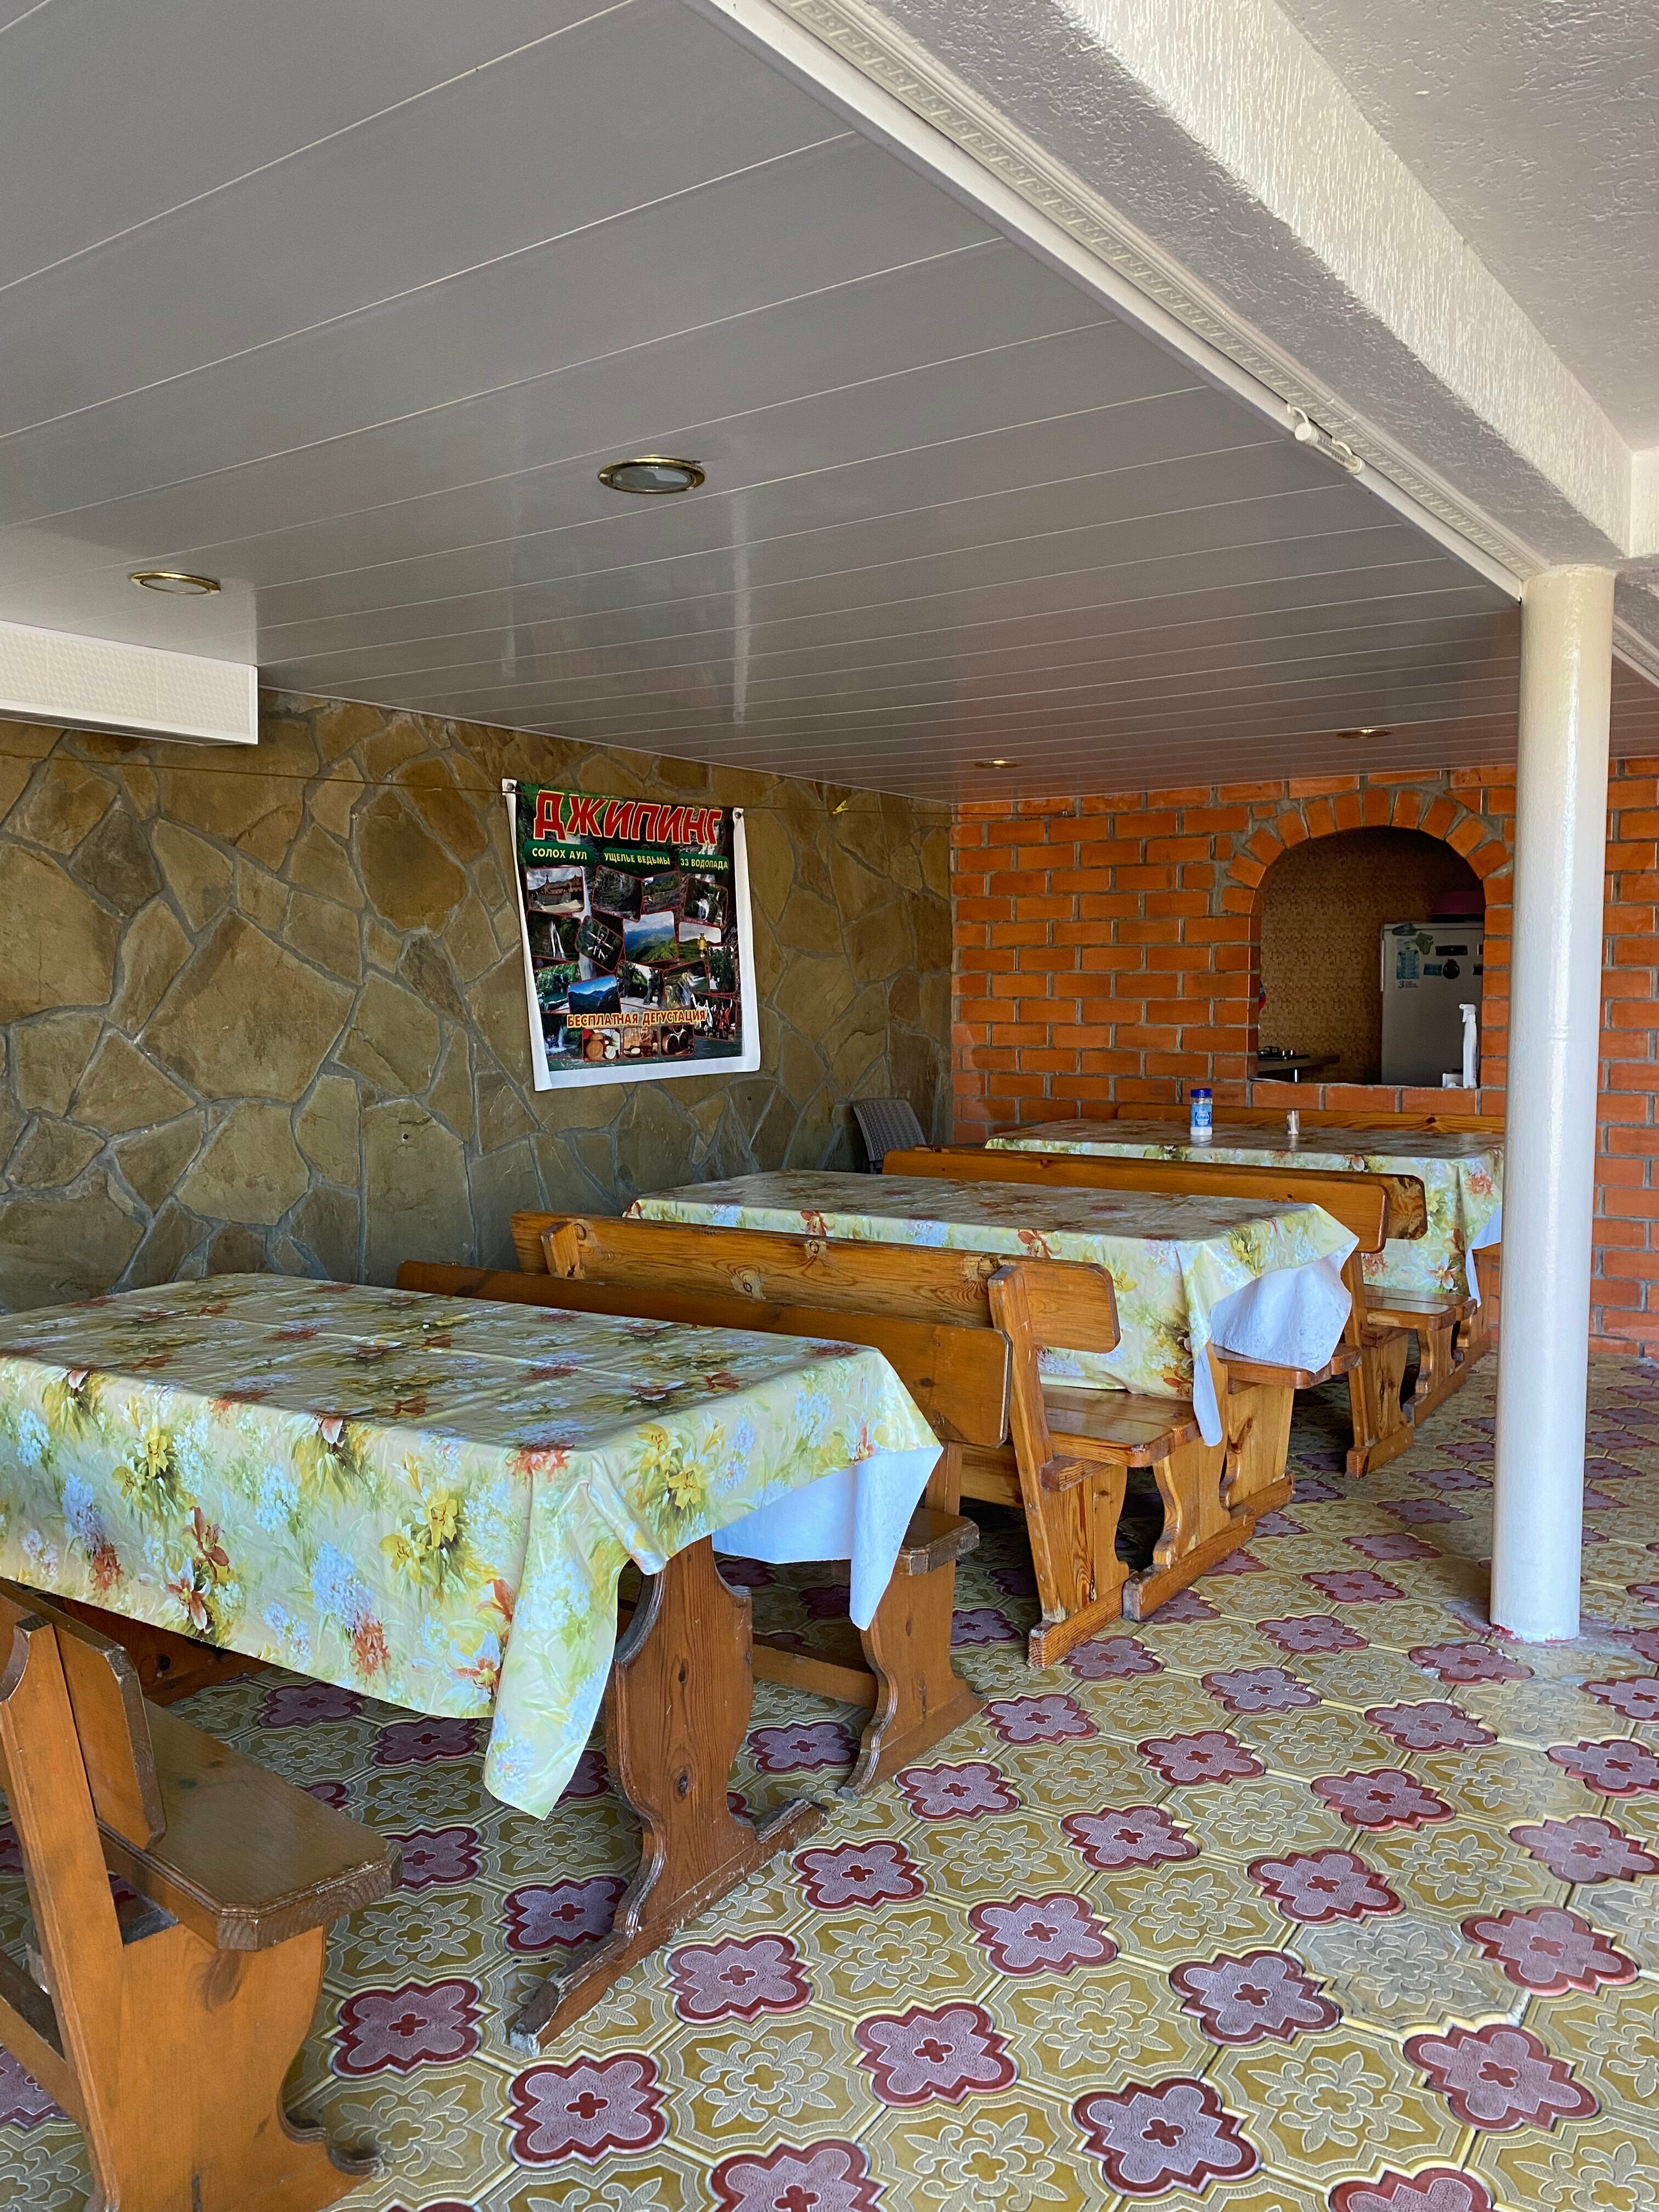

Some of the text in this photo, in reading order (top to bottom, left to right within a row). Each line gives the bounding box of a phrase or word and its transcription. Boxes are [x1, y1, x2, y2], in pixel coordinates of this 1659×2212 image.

[533, 789, 723, 845] ДЖИПИНГ
[532, 848, 587, 860] СОЛОХ АУЛ
[604, 853, 670, 865] УЩЕЛЬЕ ВЕДЬМЫ
[680, 858, 728, 870] 33 ВОДОПАДА
[567, 1010, 706, 1028] БЕСПЛАТНАЯ ДЕГУСТАЦИЯ
